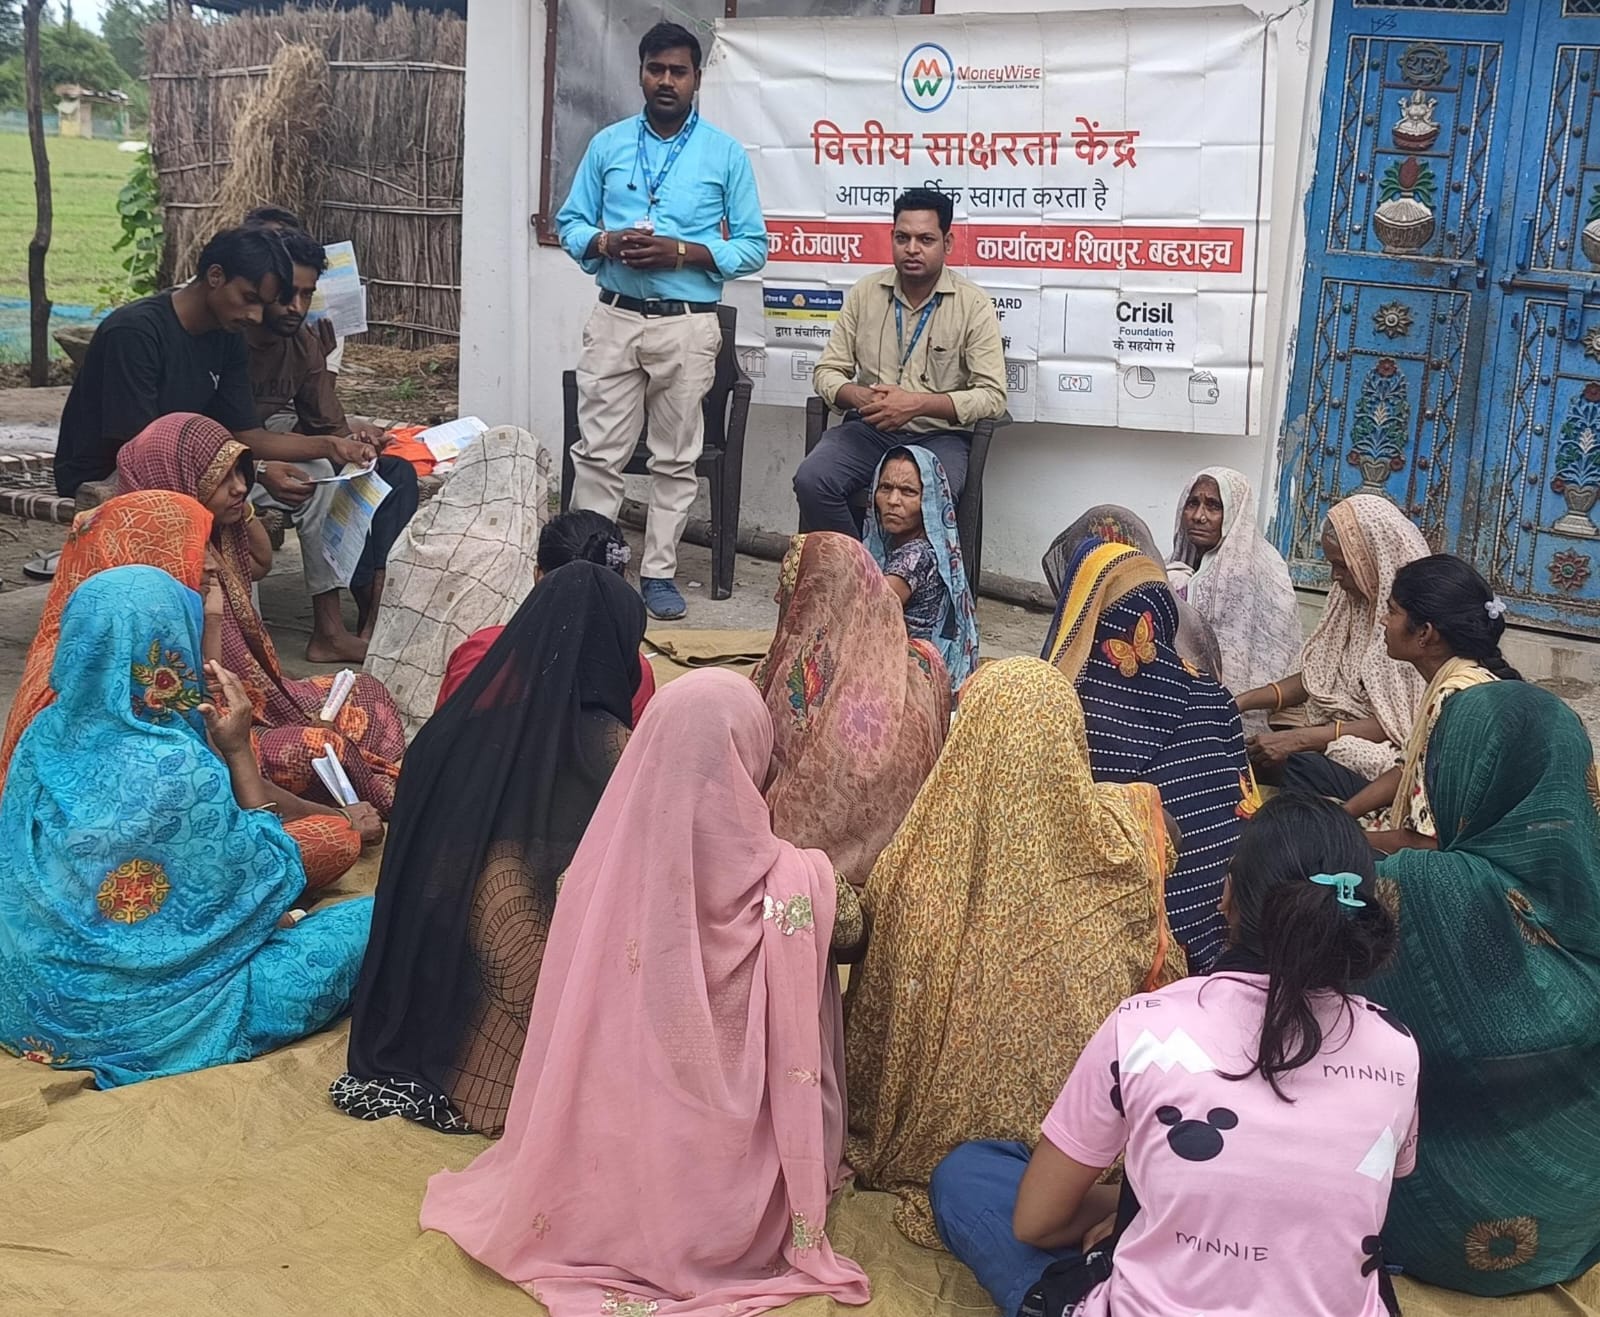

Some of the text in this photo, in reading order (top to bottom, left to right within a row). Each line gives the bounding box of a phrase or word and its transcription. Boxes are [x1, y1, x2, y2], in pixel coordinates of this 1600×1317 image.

[957, 65, 1041, 82] MoneyWise
[810, 117, 1140, 170] वित्तीय साक्षरता केंद्र
[836, 185, 898, 206] आपका
[968, 187, 1027, 208] स्वागत
[1032, 187, 1087, 208] करता
[1092, 178, 1109, 211] है
[791, 226, 863, 263] तेजवापुर
[1148, 239, 1233, 268] बहराइच
[1116, 301, 1173, 324] Crisil
[774, 325, 831, 338] द्वारा संचालित
[1119, 326, 1173, 337] Foundation
[1113, 337, 1176, 353] के सहयोग से
[1323, 1064, 1407, 1086] MINNIE
[1176, 1231, 1268, 1261] MINNIE
